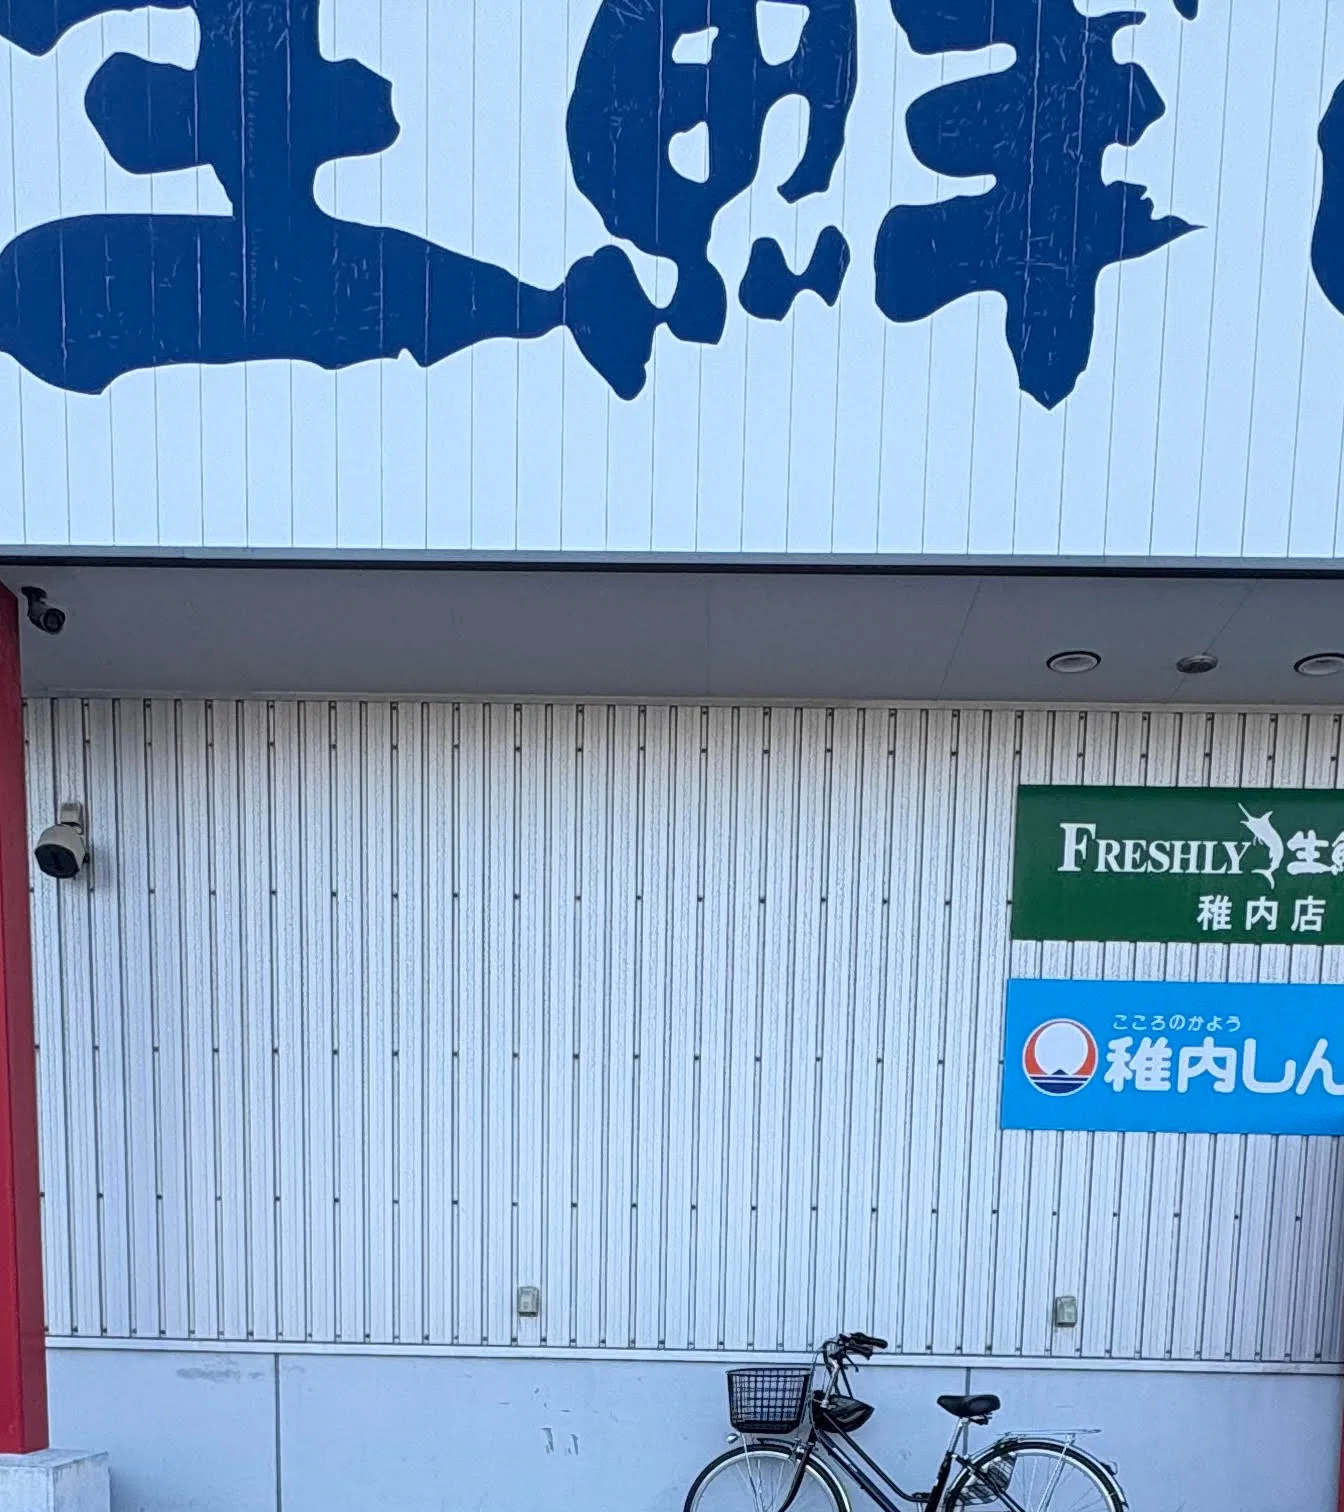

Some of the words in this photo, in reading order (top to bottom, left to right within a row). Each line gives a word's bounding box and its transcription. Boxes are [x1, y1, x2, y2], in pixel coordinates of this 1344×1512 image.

[1057, 822, 1252, 875] FRESHLY
[1195, 894, 1327, 932] 稚内店
[1112, 1013, 1242, 1032] こころのかよう
